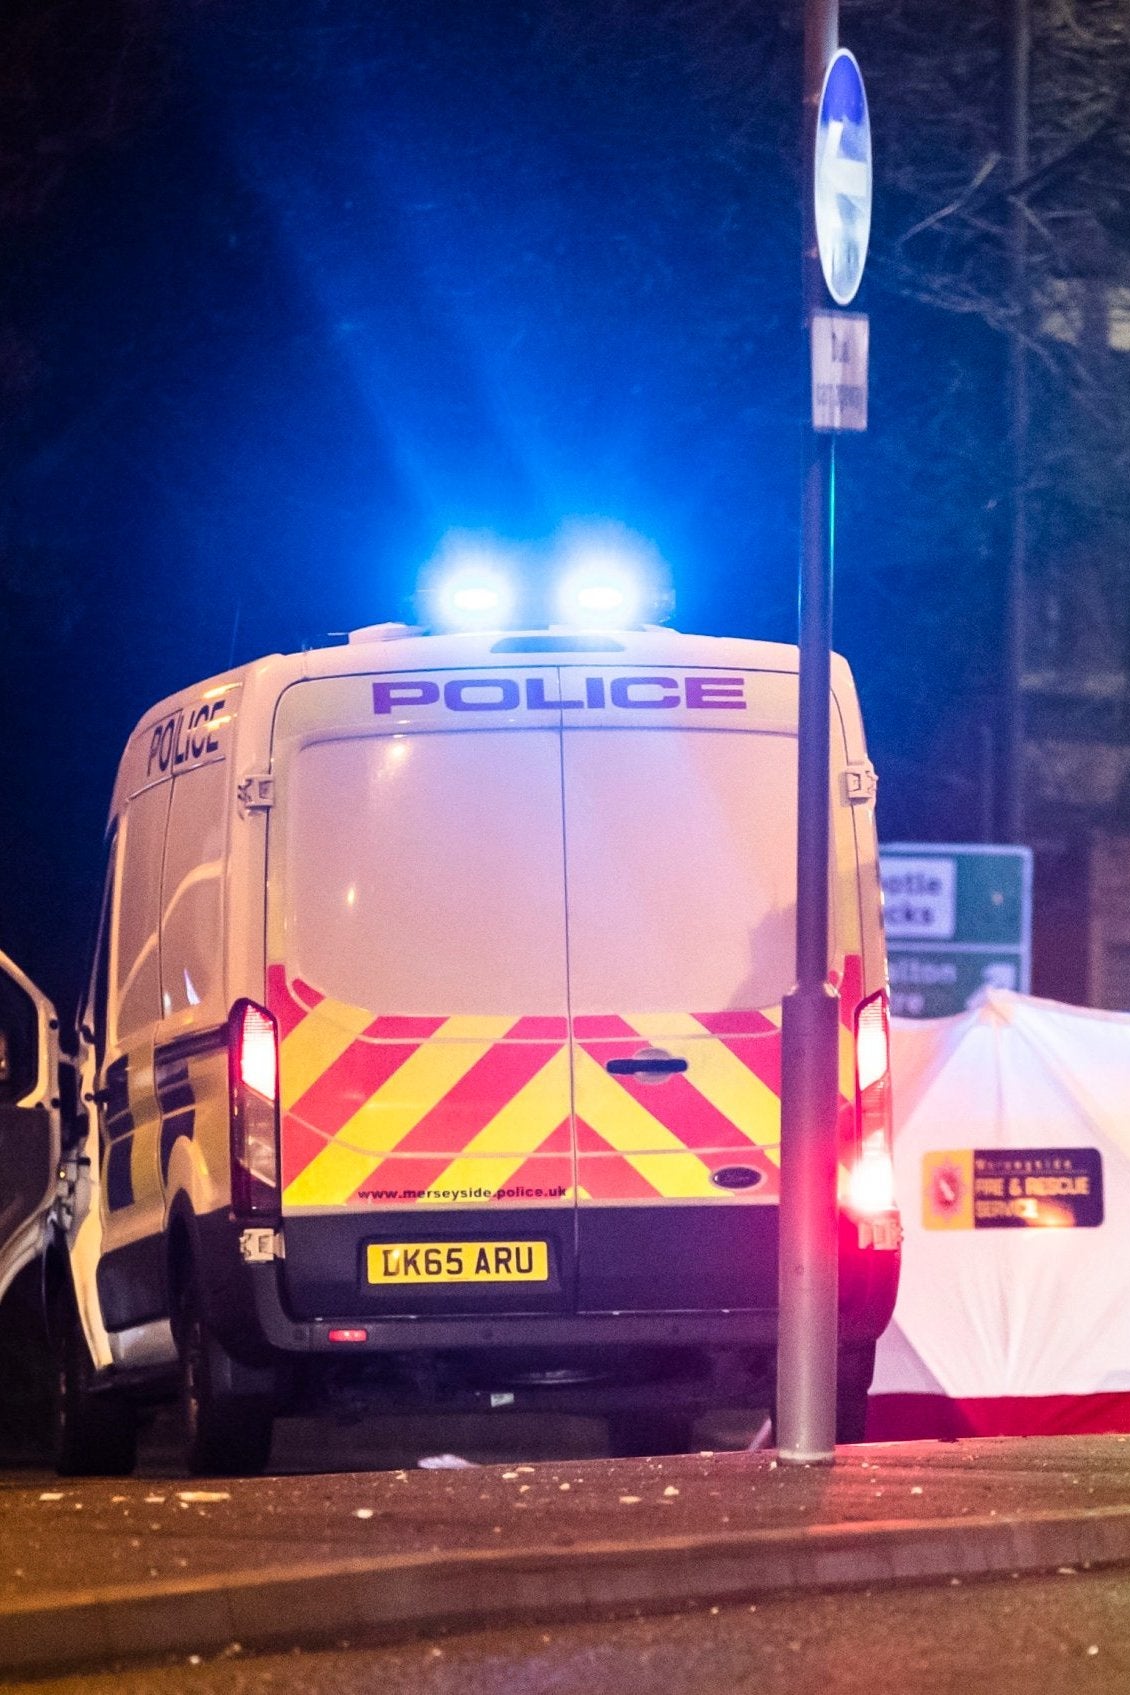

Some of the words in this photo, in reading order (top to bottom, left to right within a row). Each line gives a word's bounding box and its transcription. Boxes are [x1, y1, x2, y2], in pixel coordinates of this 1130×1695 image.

[372, 676, 748, 714] POLICE
[147, 699, 225, 777] POLICE
[885, 903, 934, 925] cks
[358, 1186, 566, 1200] www.merseyside.police.uk
[1008, 1177, 1023, 1196] &
[1025, 1176, 1090, 1196] RESCUE
[382, 1248, 463, 1276] DK65
[475, 1246, 533, 1274] ARU
